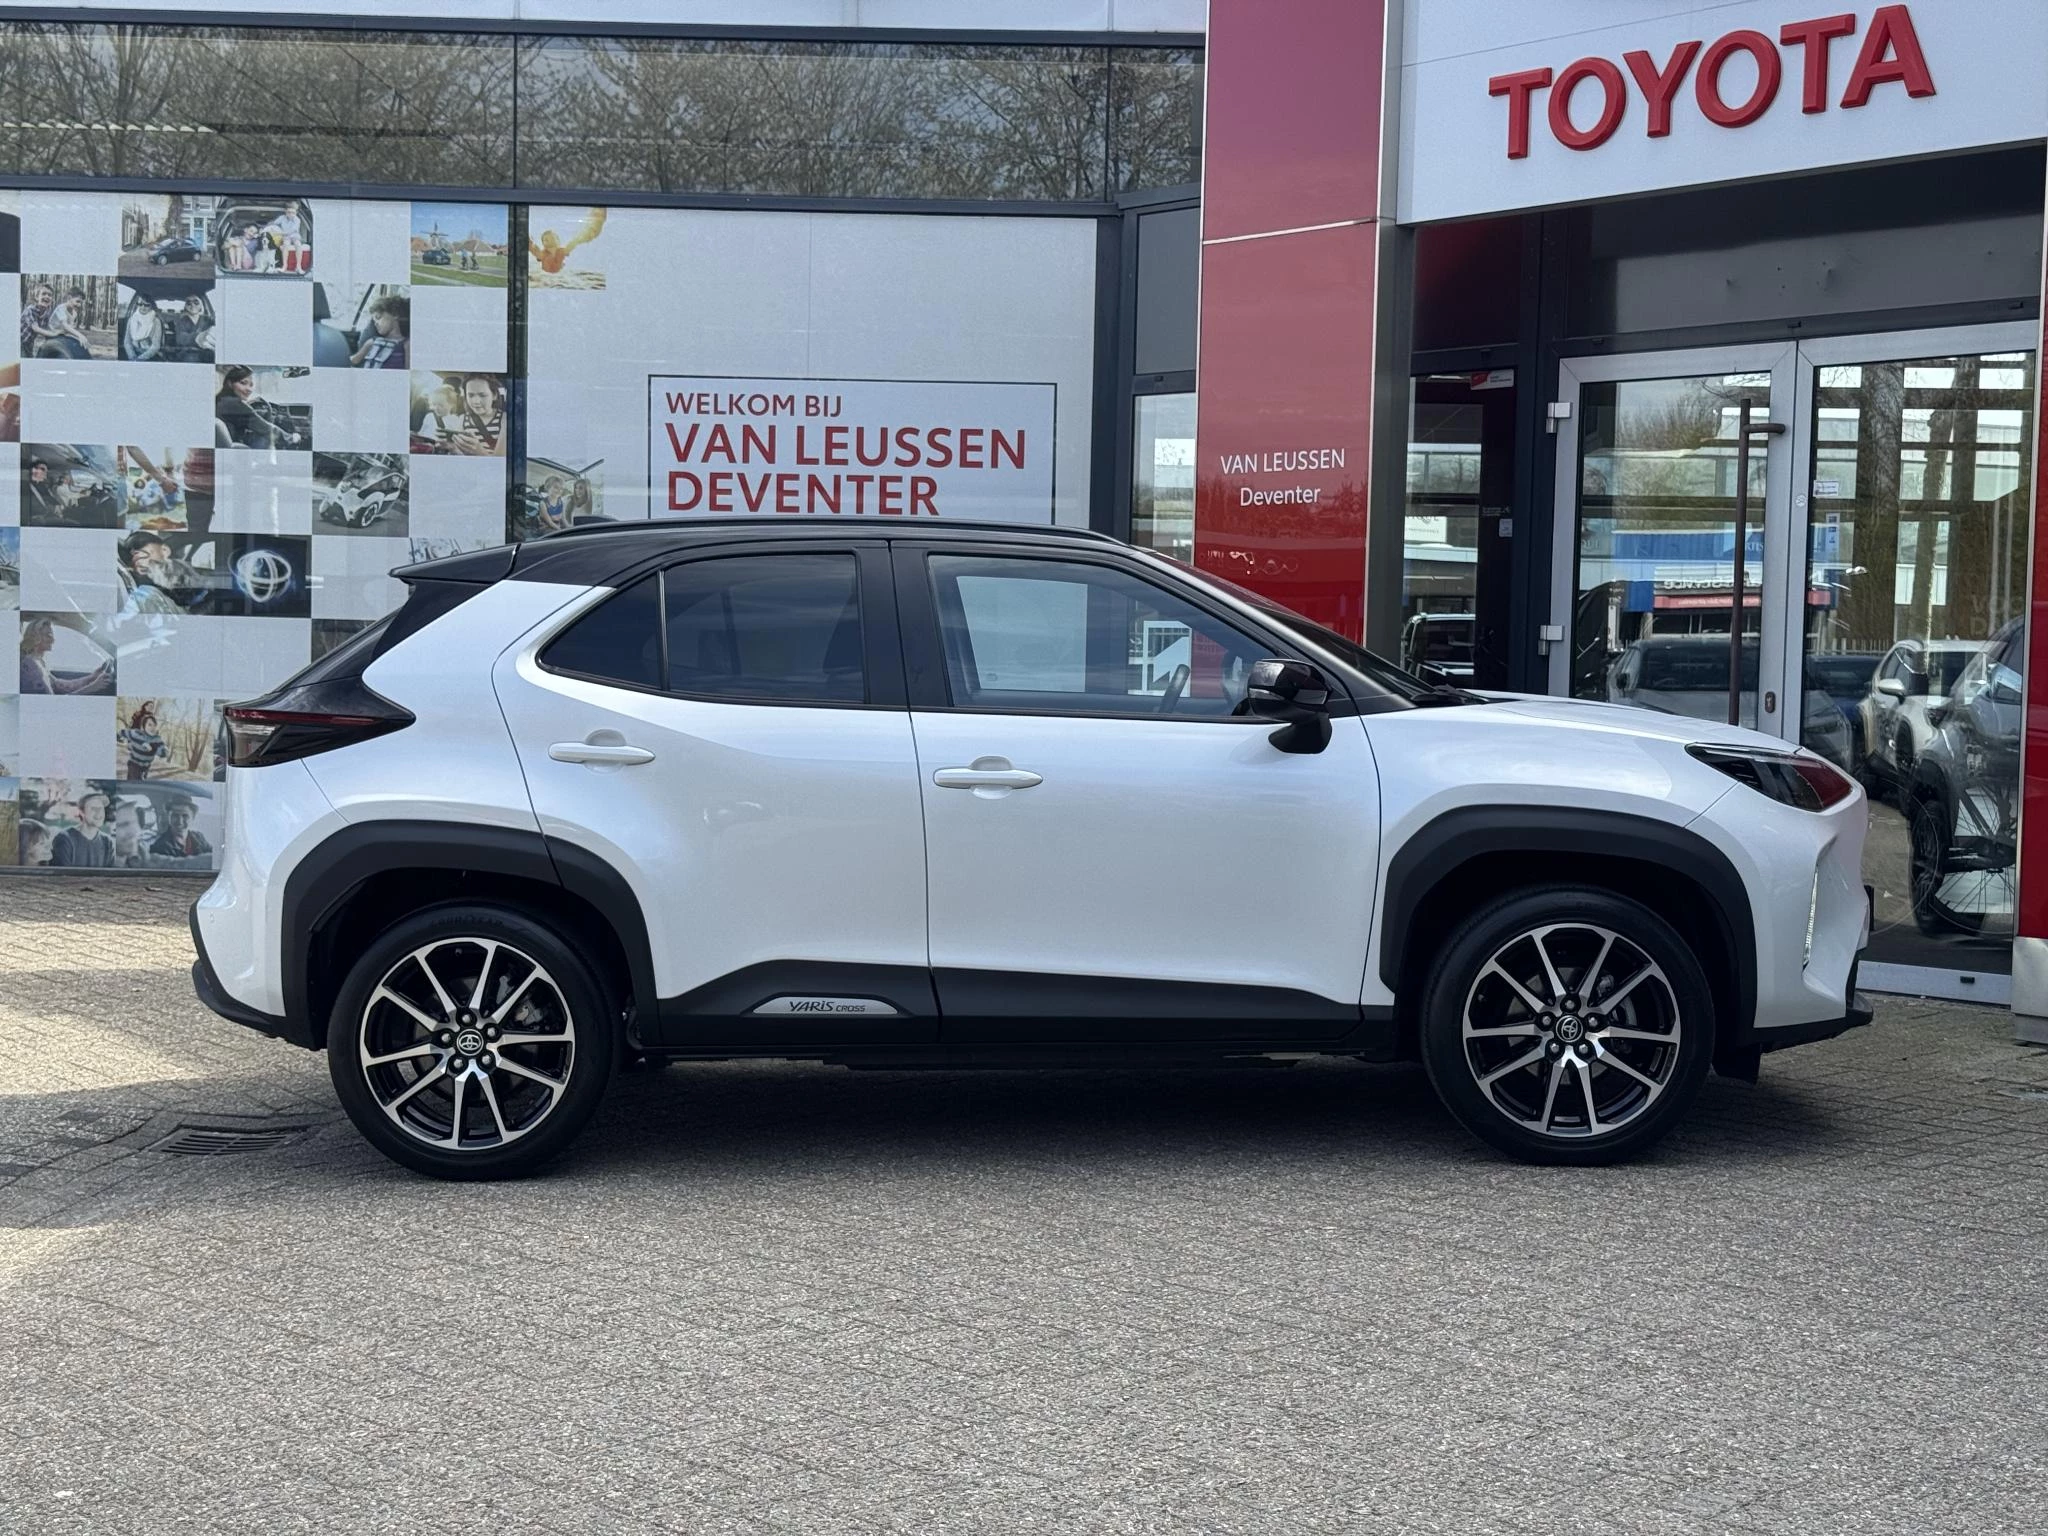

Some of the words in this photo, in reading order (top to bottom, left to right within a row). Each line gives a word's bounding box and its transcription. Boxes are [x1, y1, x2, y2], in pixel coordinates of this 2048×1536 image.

[1489, 4, 1935, 160] TOYOTA
[665, 392, 796, 417] WELKOM
[804, 393, 843, 418] BIJ
[665, 422, 777, 464] VAN
[796, 426, 1026, 470] LEUSSEN
[1220, 453, 1259, 475] VAN
[1263, 447, 1346, 473] LEUSSEN
[668, 471, 939, 516] DEVENTER
[1240, 486, 1322, 507] Deventer
[835, 1004, 866, 1013] CROSS
